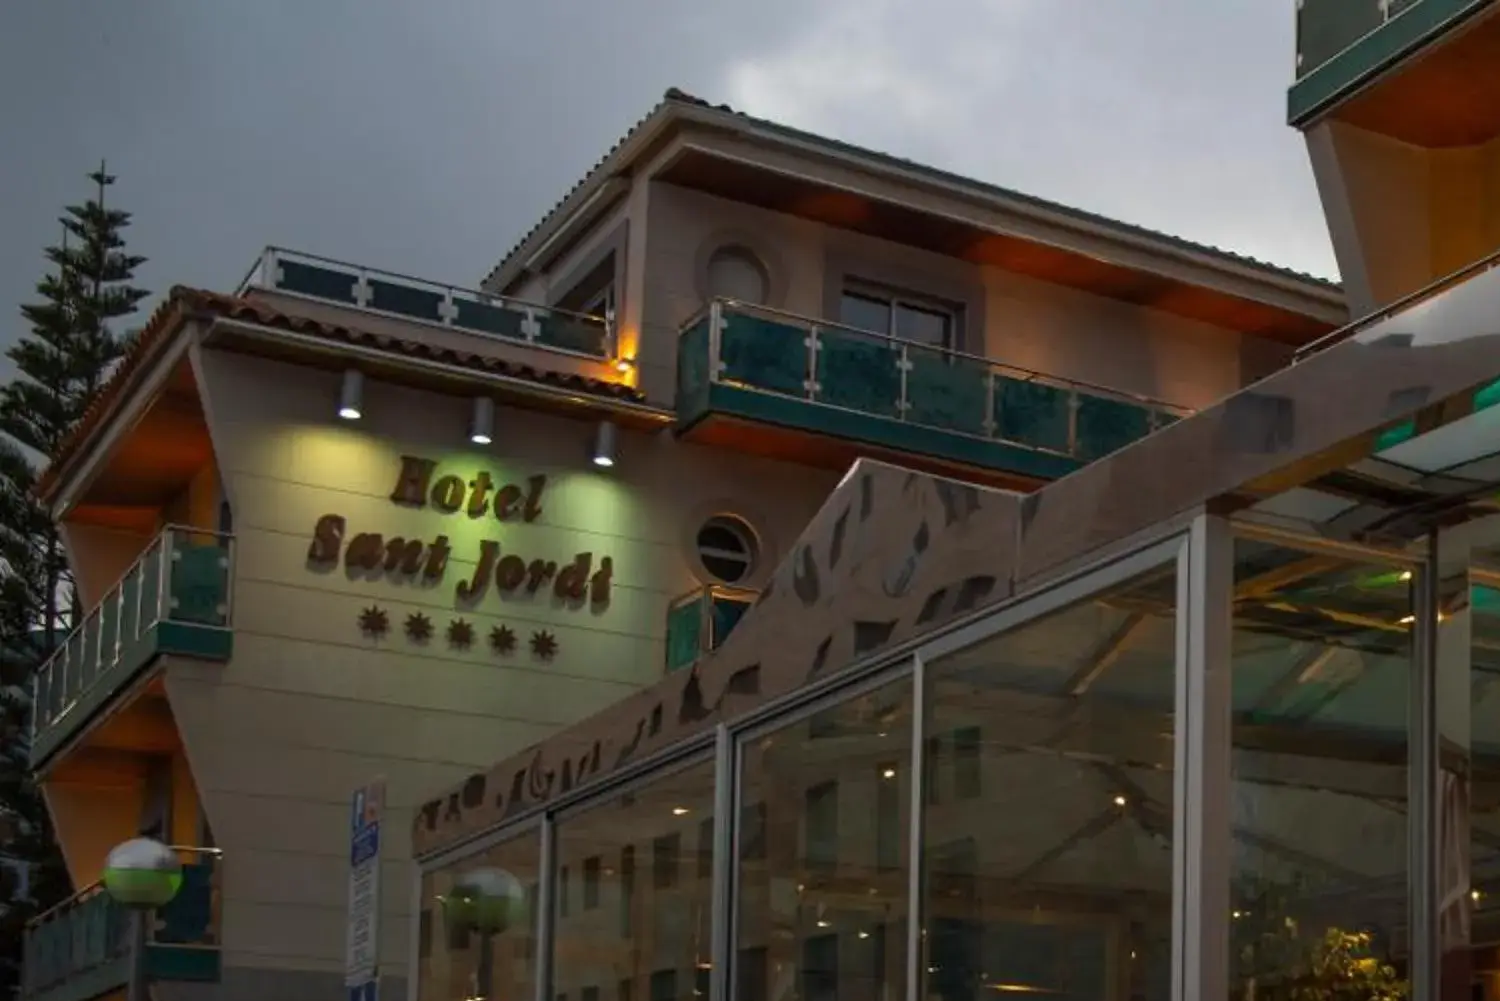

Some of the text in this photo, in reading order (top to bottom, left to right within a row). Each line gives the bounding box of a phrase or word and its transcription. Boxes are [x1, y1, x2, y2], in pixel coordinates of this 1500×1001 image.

[391, 456, 547, 523] Hotel
[308, 514, 613, 606] Sant Jordi
